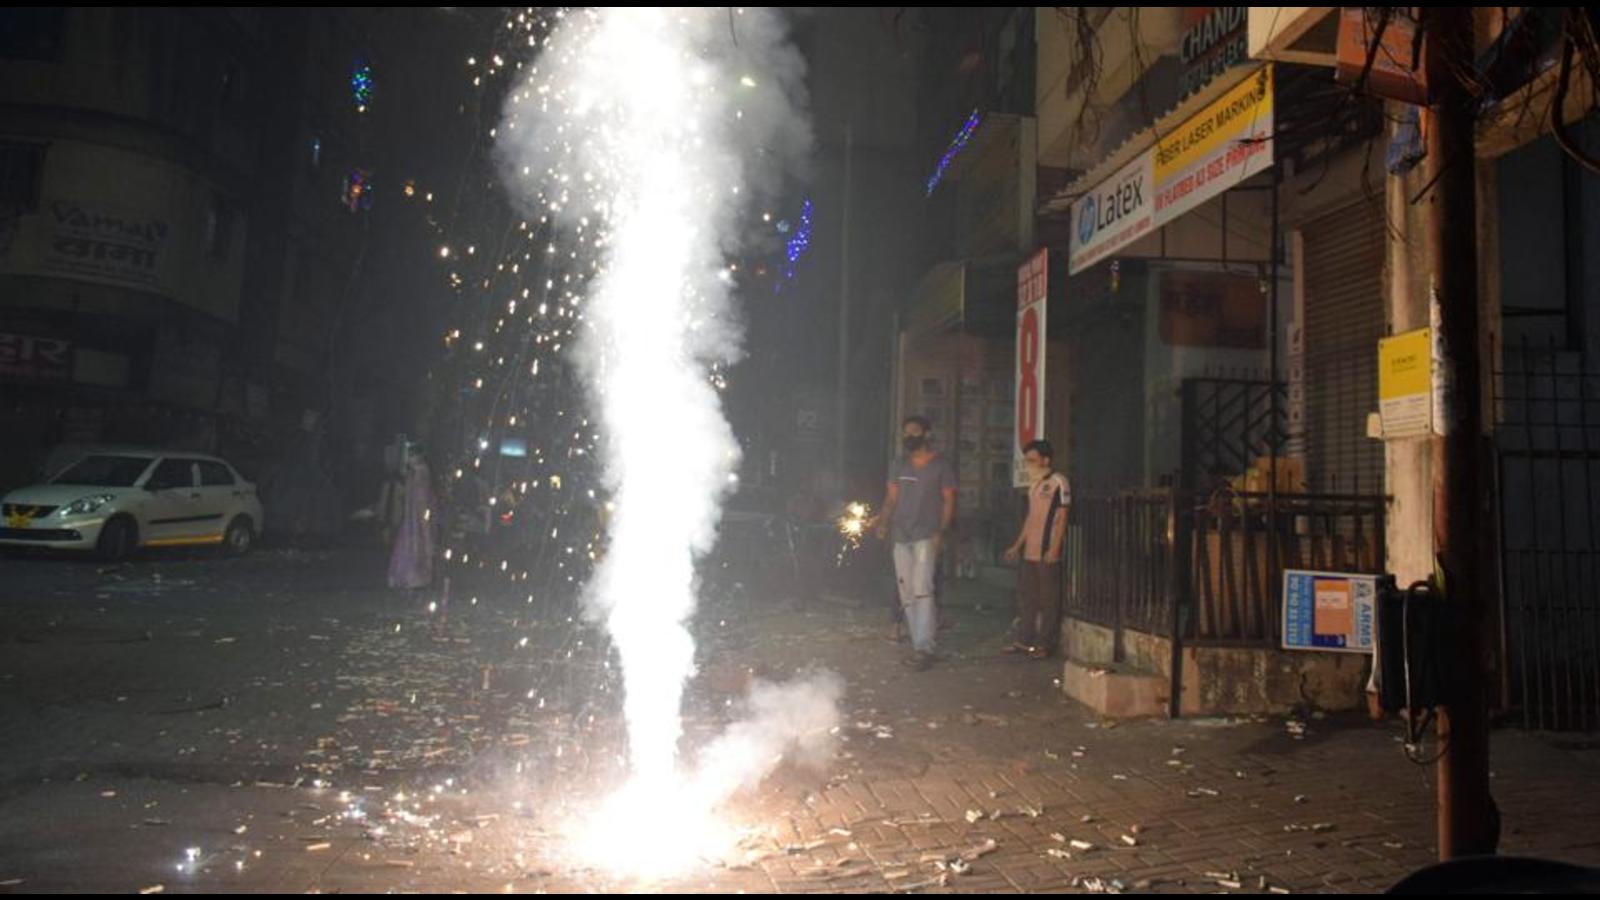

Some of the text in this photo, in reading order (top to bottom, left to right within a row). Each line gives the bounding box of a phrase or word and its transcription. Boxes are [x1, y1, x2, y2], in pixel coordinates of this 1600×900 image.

[1182, 118, 1214, 151] LASER
[1097, 174, 1143, 232] Latex
[1360, 603, 1371, 646] ARMS
